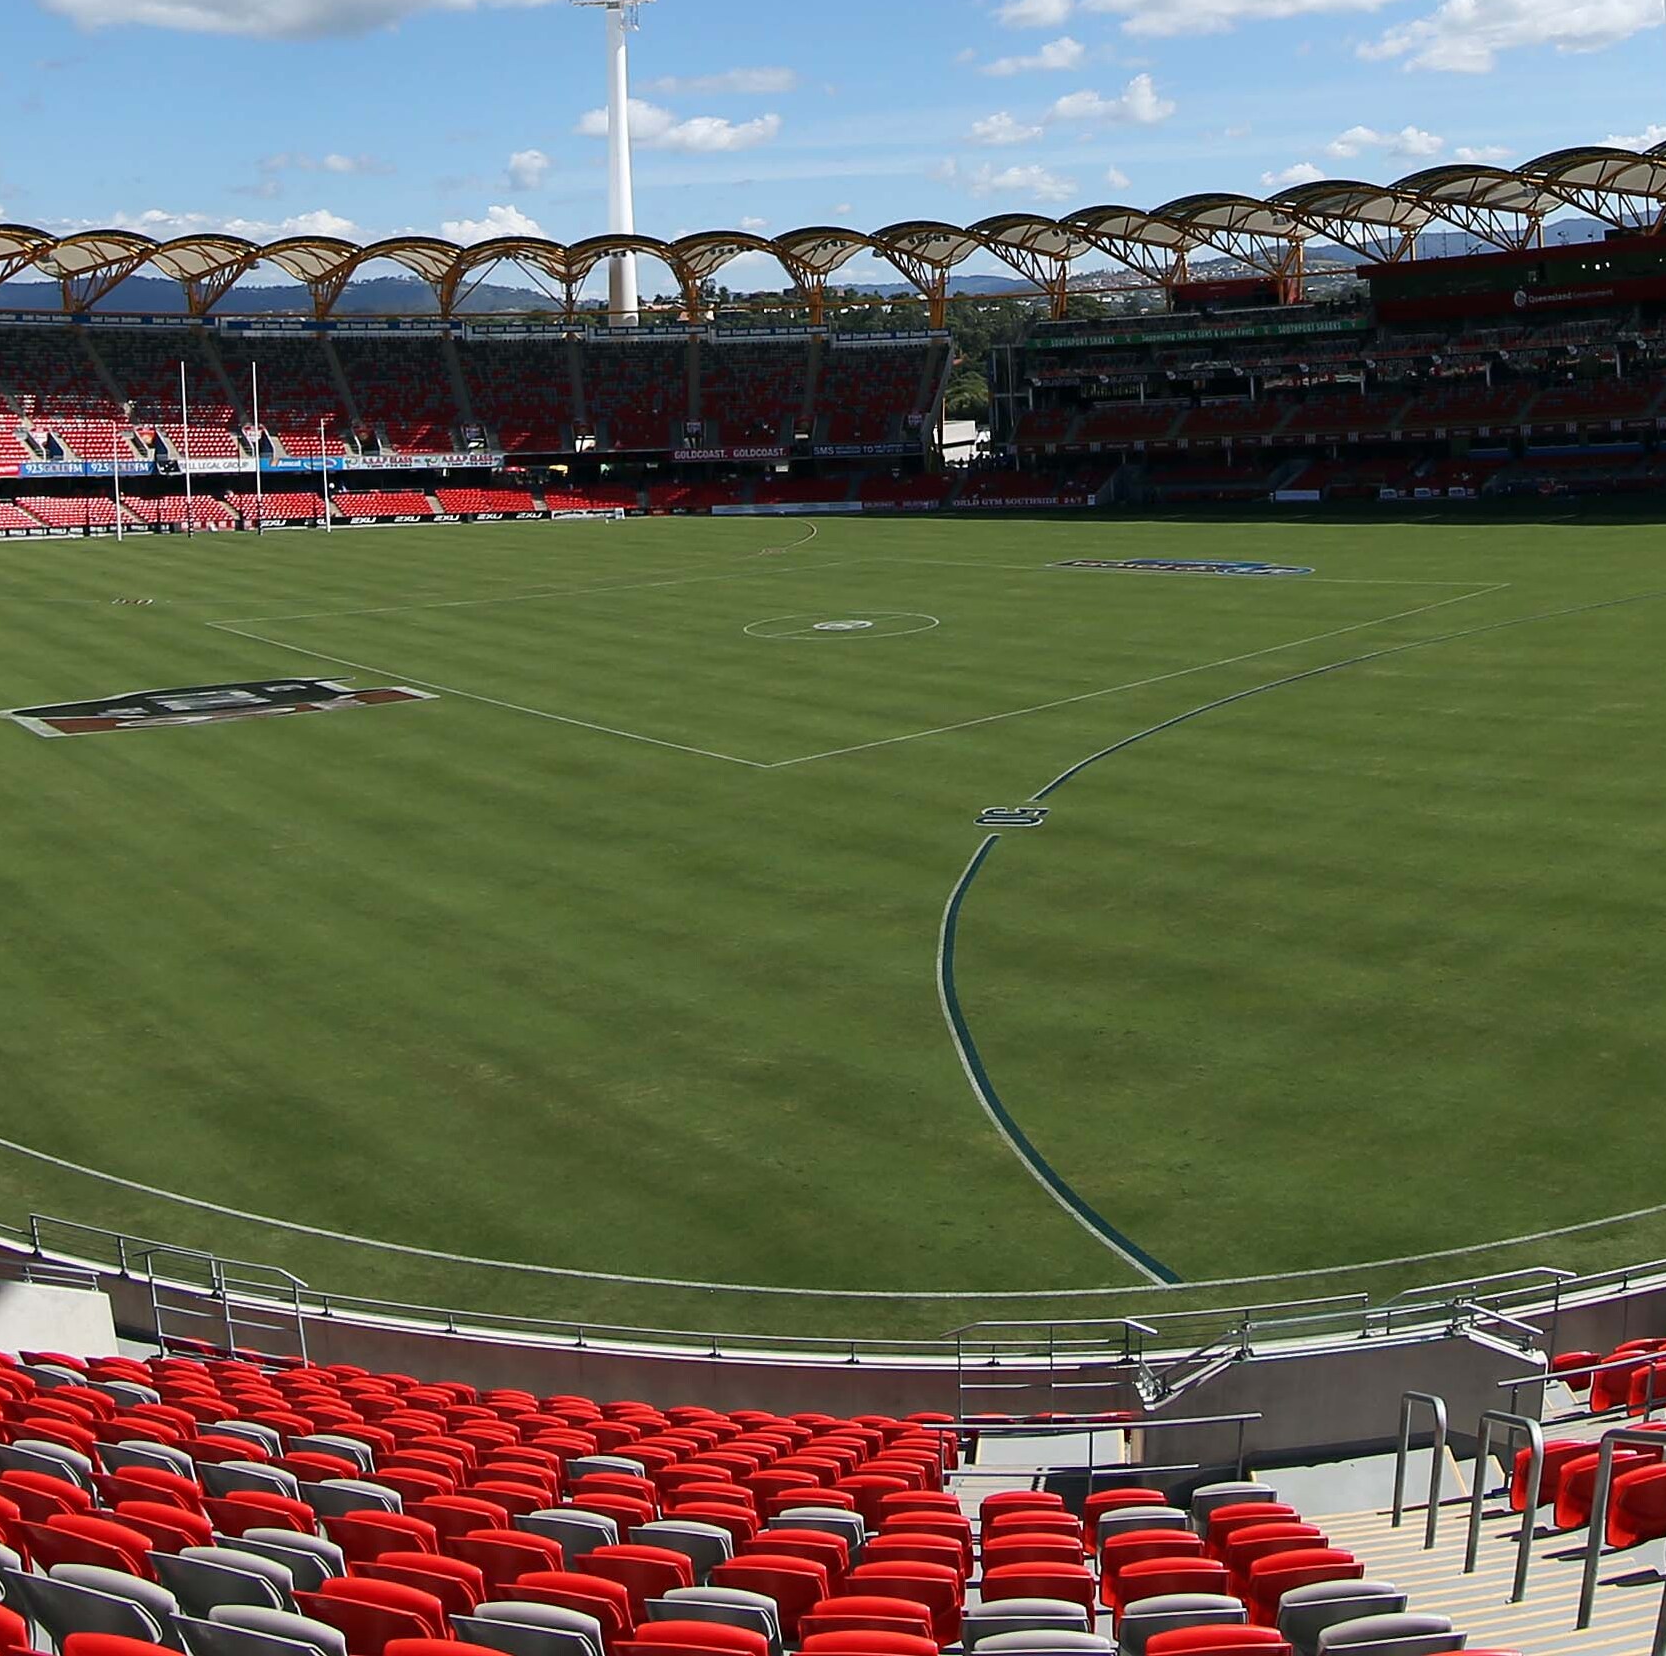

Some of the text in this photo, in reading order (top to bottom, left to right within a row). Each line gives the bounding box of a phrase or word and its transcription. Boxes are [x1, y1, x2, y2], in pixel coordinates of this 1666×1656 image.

[1528, 292, 1572, 303] Queensland
[1278, 321, 1341, 334] SOUTHPORT SHARKS
[1051, 336, 1115, 347] SOUTHPORT SHARKS
[1141, 333, 1175, 344] Supporting
[1220, 329, 1237, 337] Local
[674, 449, 728, 460] GOLDCOAST.
[733, 447, 787, 458] GOLDCOAST.
[813, 446, 834, 456] SMS
[390, 455, 413, 463] GLASS
[1004, 497, 1059, 506] SOUTHSIDE
